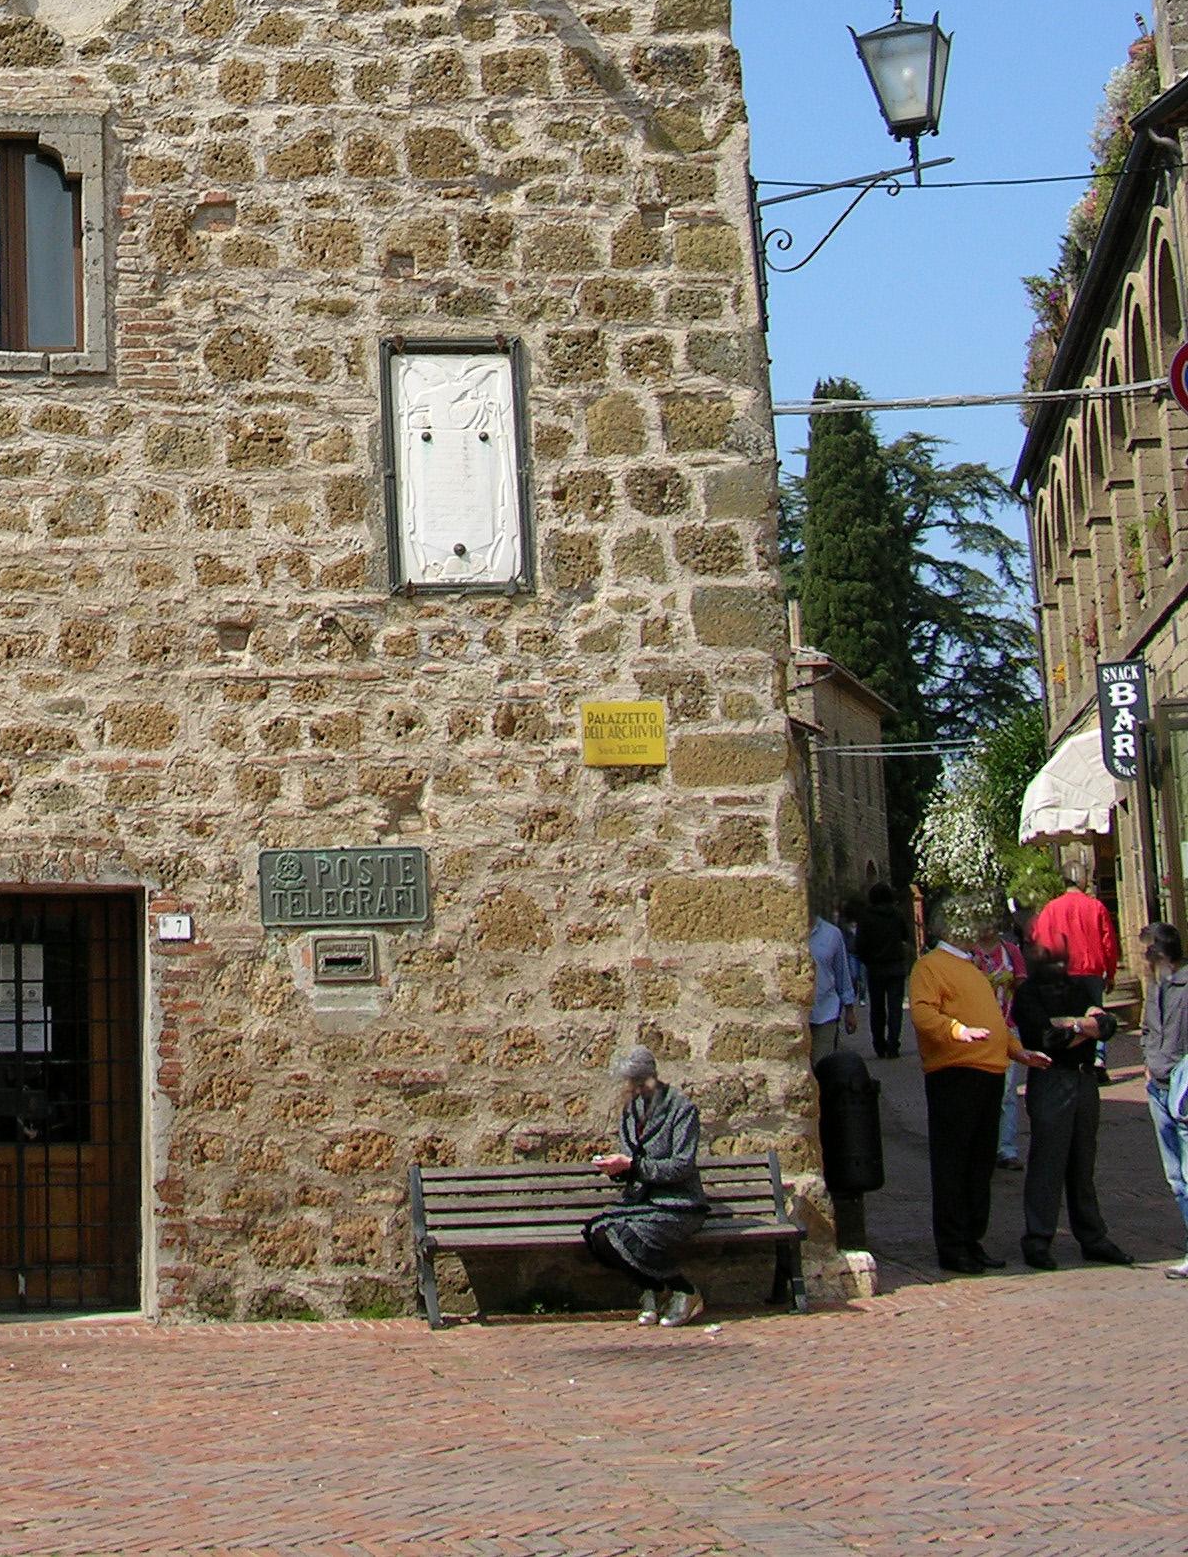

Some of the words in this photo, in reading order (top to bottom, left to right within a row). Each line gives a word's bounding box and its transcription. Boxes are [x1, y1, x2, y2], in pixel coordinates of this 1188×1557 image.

[1102, 665, 1140, 682] SNACK
[587, 712, 657, 724] PALAZZETTO
[1108, 682, 1138, 757] BAR
[314, 854, 417, 887] POSTE
[270, 886, 418, 917] TELEGRAFI
[176, 919, 182, 933] 7
